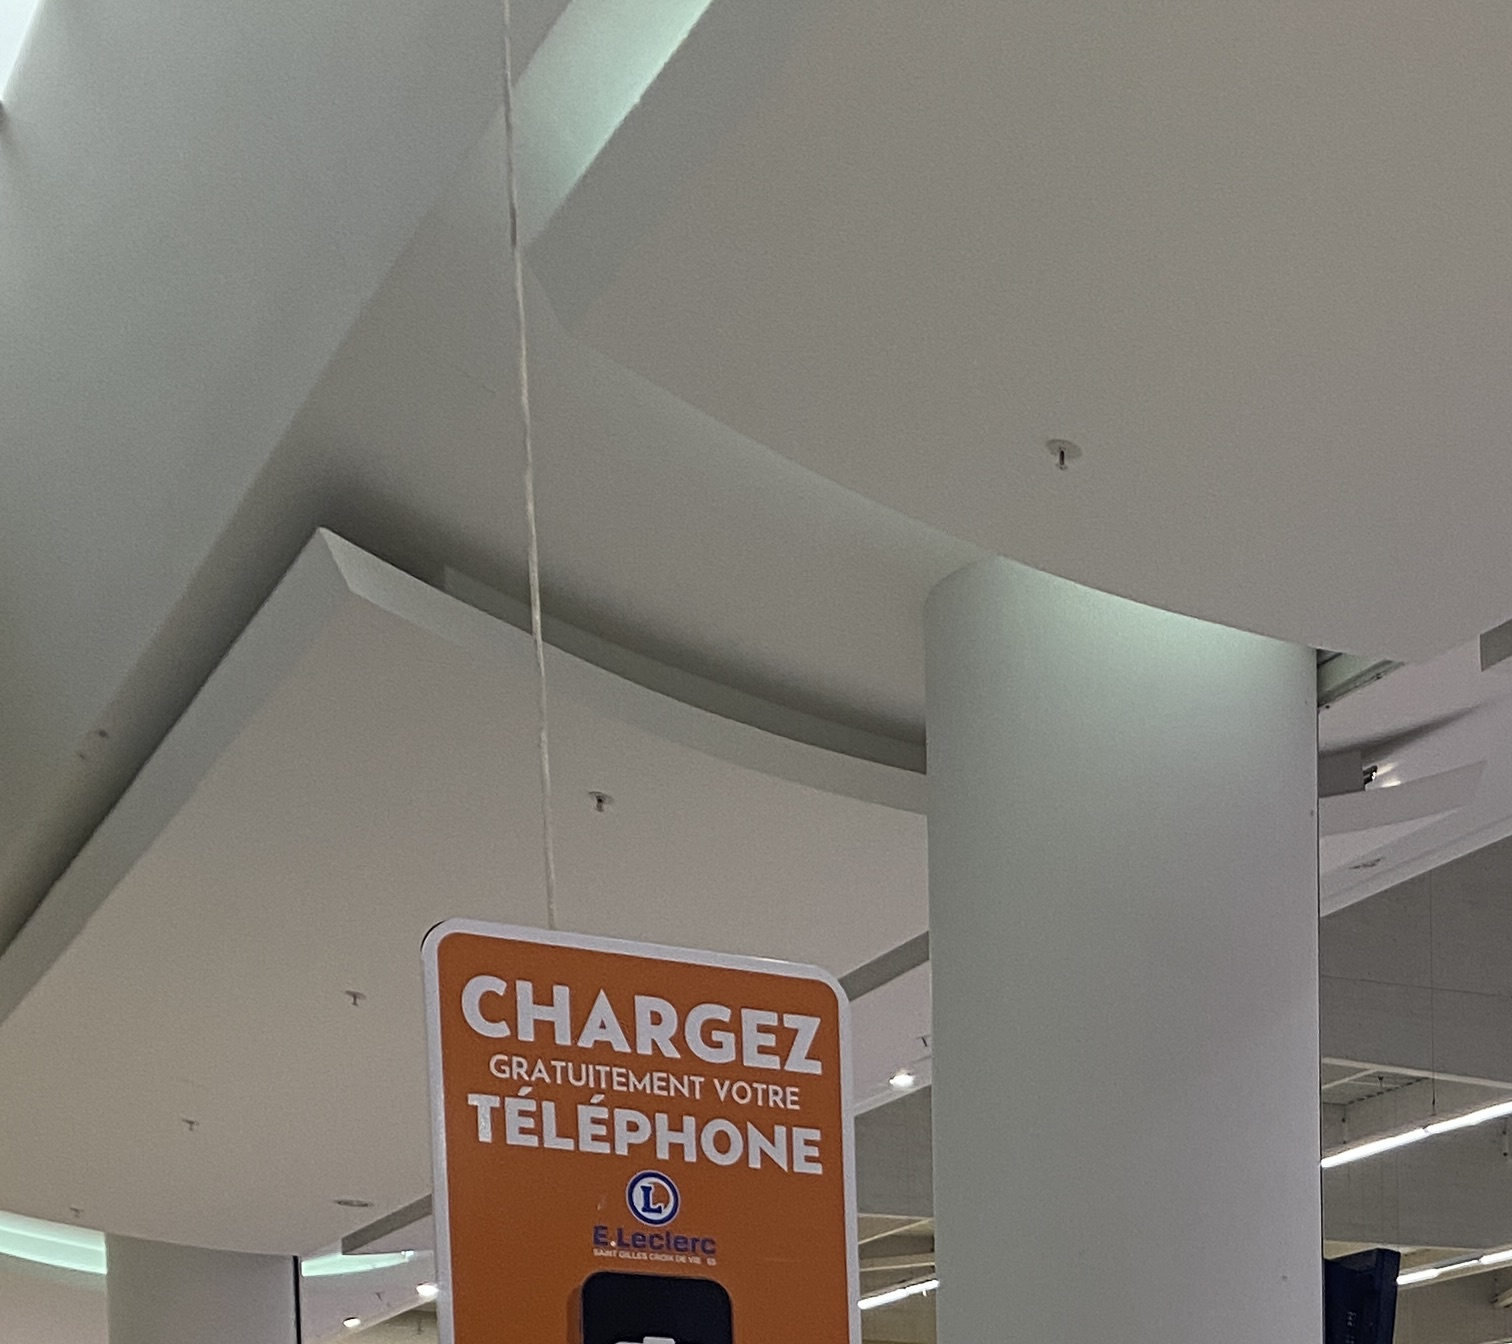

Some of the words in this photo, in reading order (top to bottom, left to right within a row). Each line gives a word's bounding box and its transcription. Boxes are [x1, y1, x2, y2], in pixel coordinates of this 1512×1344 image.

[461, 975, 823, 1075] CHARGEZ
[489, 1054, 705, 1099] GRATUITEMENT
[713, 1078, 801, 1110] VOTRE
[467, 1086, 823, 1175] TÉLÉPHONE
[592, 1225, 718, 1255] E.Leclerc
